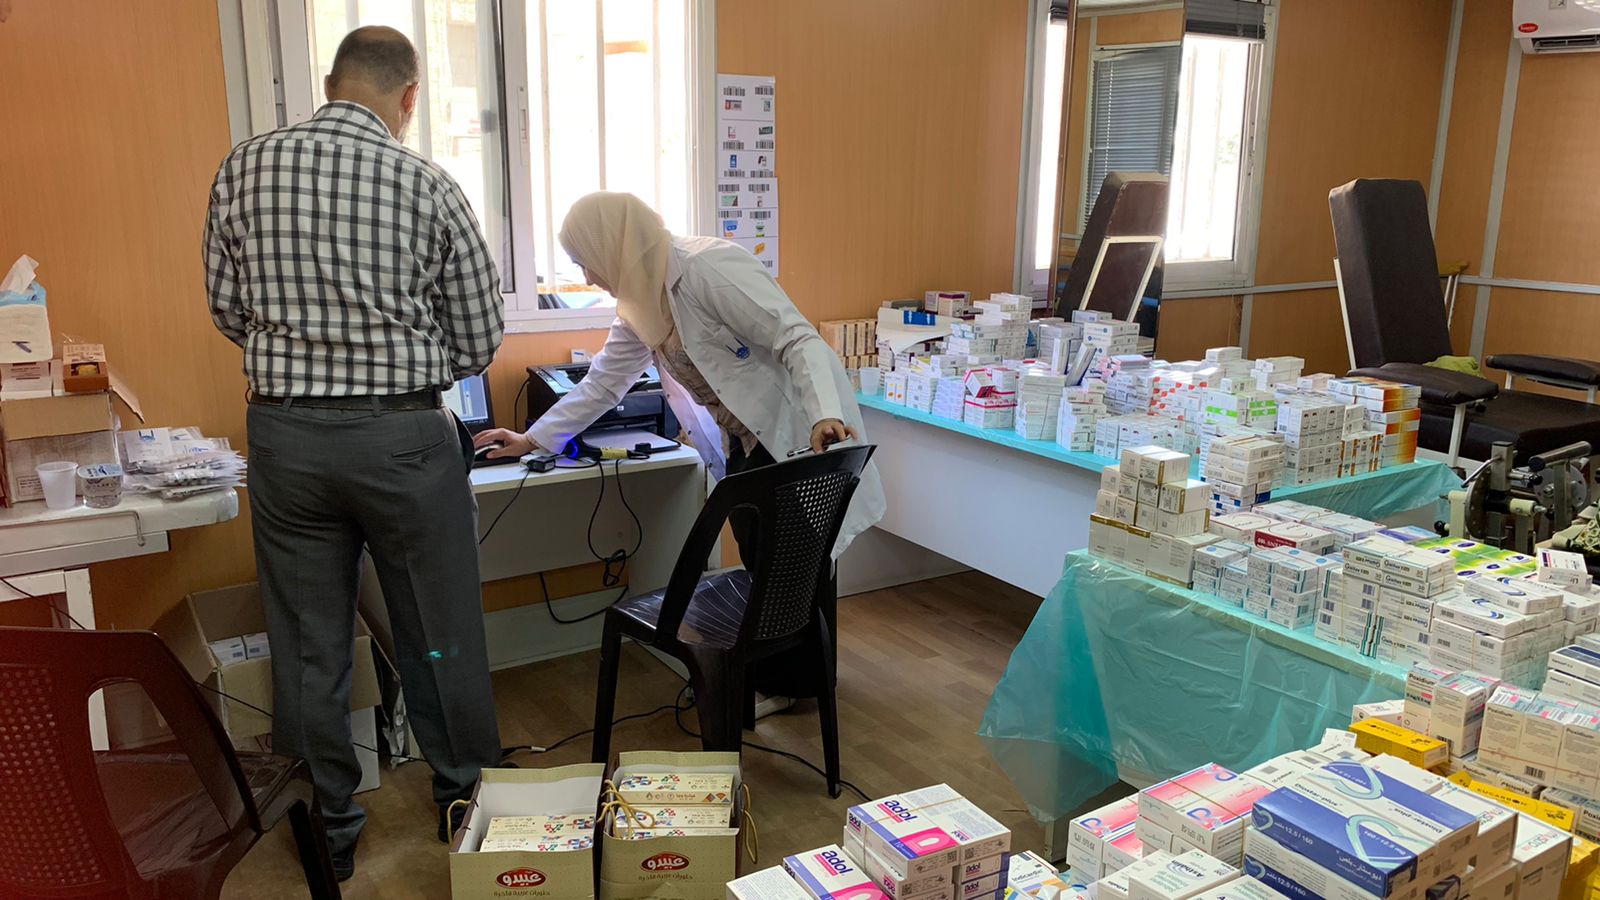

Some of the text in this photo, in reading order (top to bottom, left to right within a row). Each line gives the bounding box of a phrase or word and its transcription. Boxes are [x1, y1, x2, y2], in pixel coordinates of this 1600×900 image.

[1408, 673, 1436, 685] Poxidium
[1487, 707, 1513, 718] Poxidium
[1294, 783, 1338, 807] Diostar-plus
[884, 799, 918, 823] adol
[1394, 808, 1443, 834] Diostar-plus
[822, 850, 853, 874] adol
[966, 862, 981, 874] adol
[502, 873, 542, 886] عبيدو
[964, 882, 979, 892] adol
